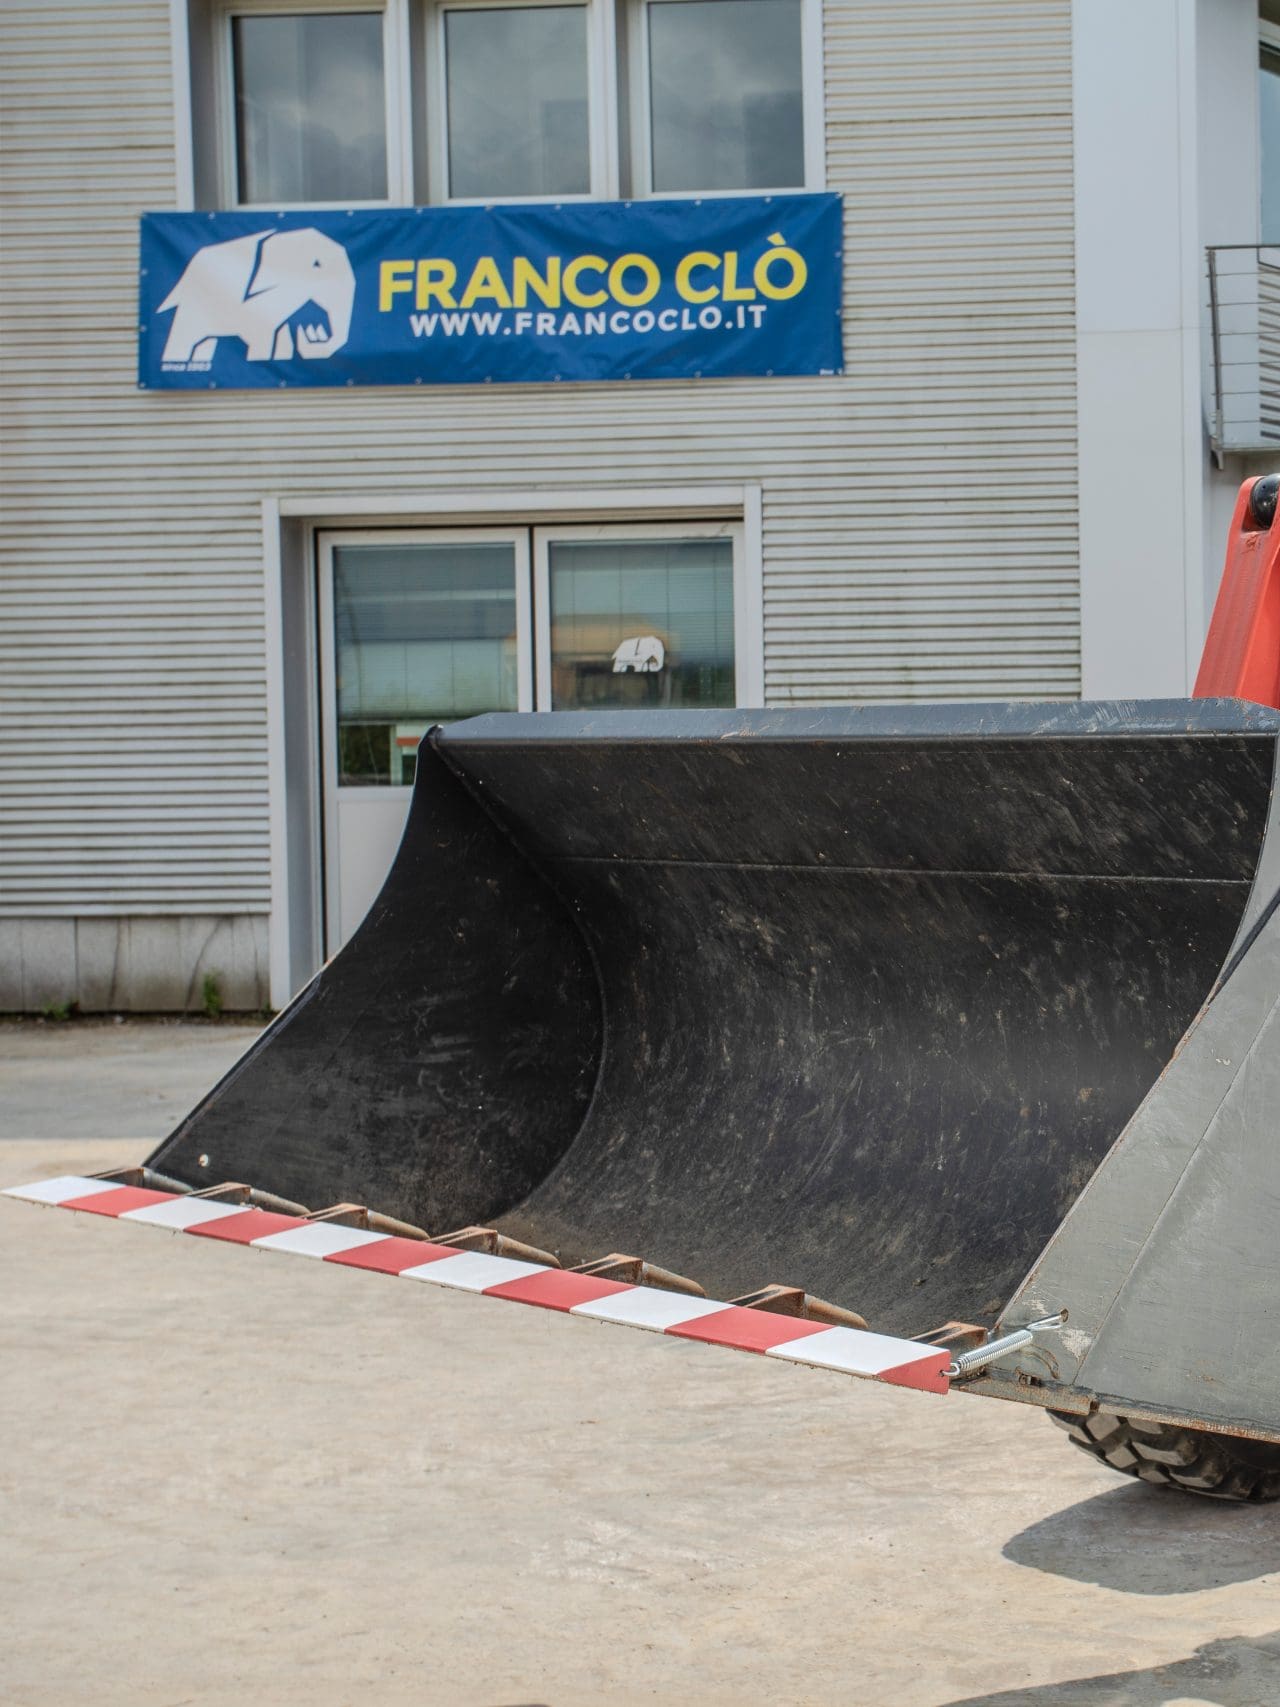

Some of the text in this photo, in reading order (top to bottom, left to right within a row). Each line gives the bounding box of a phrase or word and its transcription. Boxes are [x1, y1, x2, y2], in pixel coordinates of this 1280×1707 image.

[379, 232, 808, 312] FRANCO CLÒ
[409, 304, 768, 338] WWW.FRANCOCLO.IT
